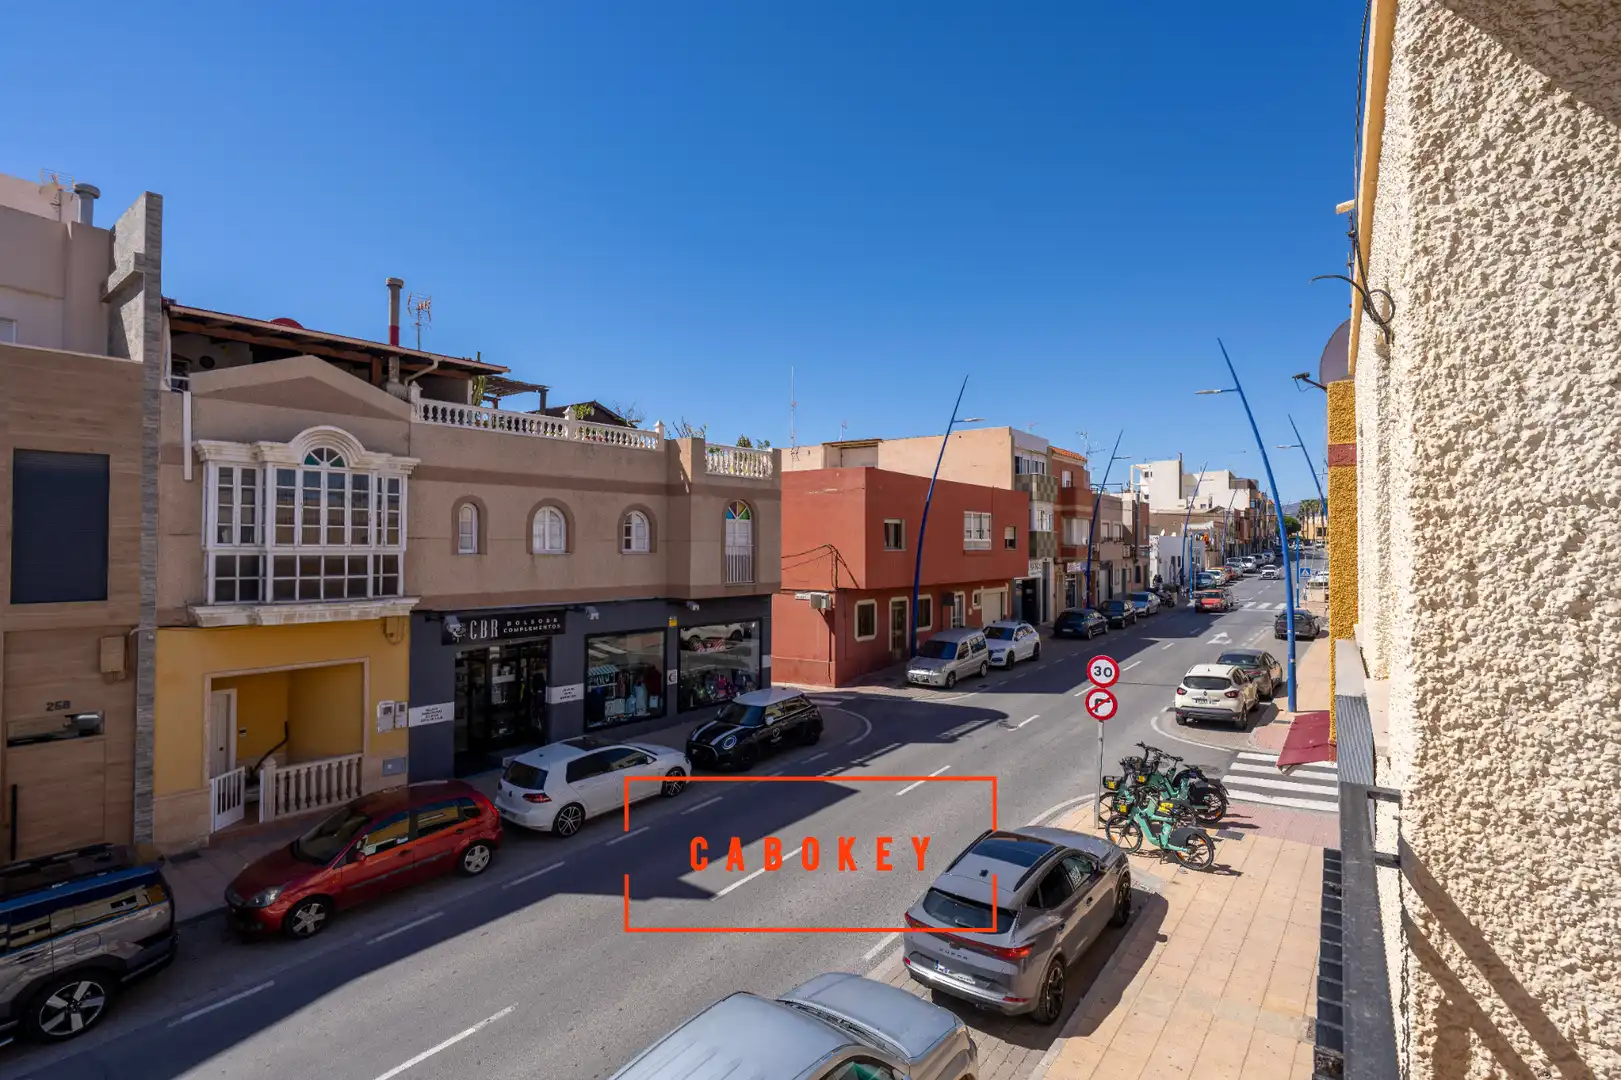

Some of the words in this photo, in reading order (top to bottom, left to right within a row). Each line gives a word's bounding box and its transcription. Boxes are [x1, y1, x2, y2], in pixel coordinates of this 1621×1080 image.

[470, 619, 498, 640] CBR
[503, 624, 561, 634] COMPLEMENTOS
[1094, 666, 1112, 678] 30
